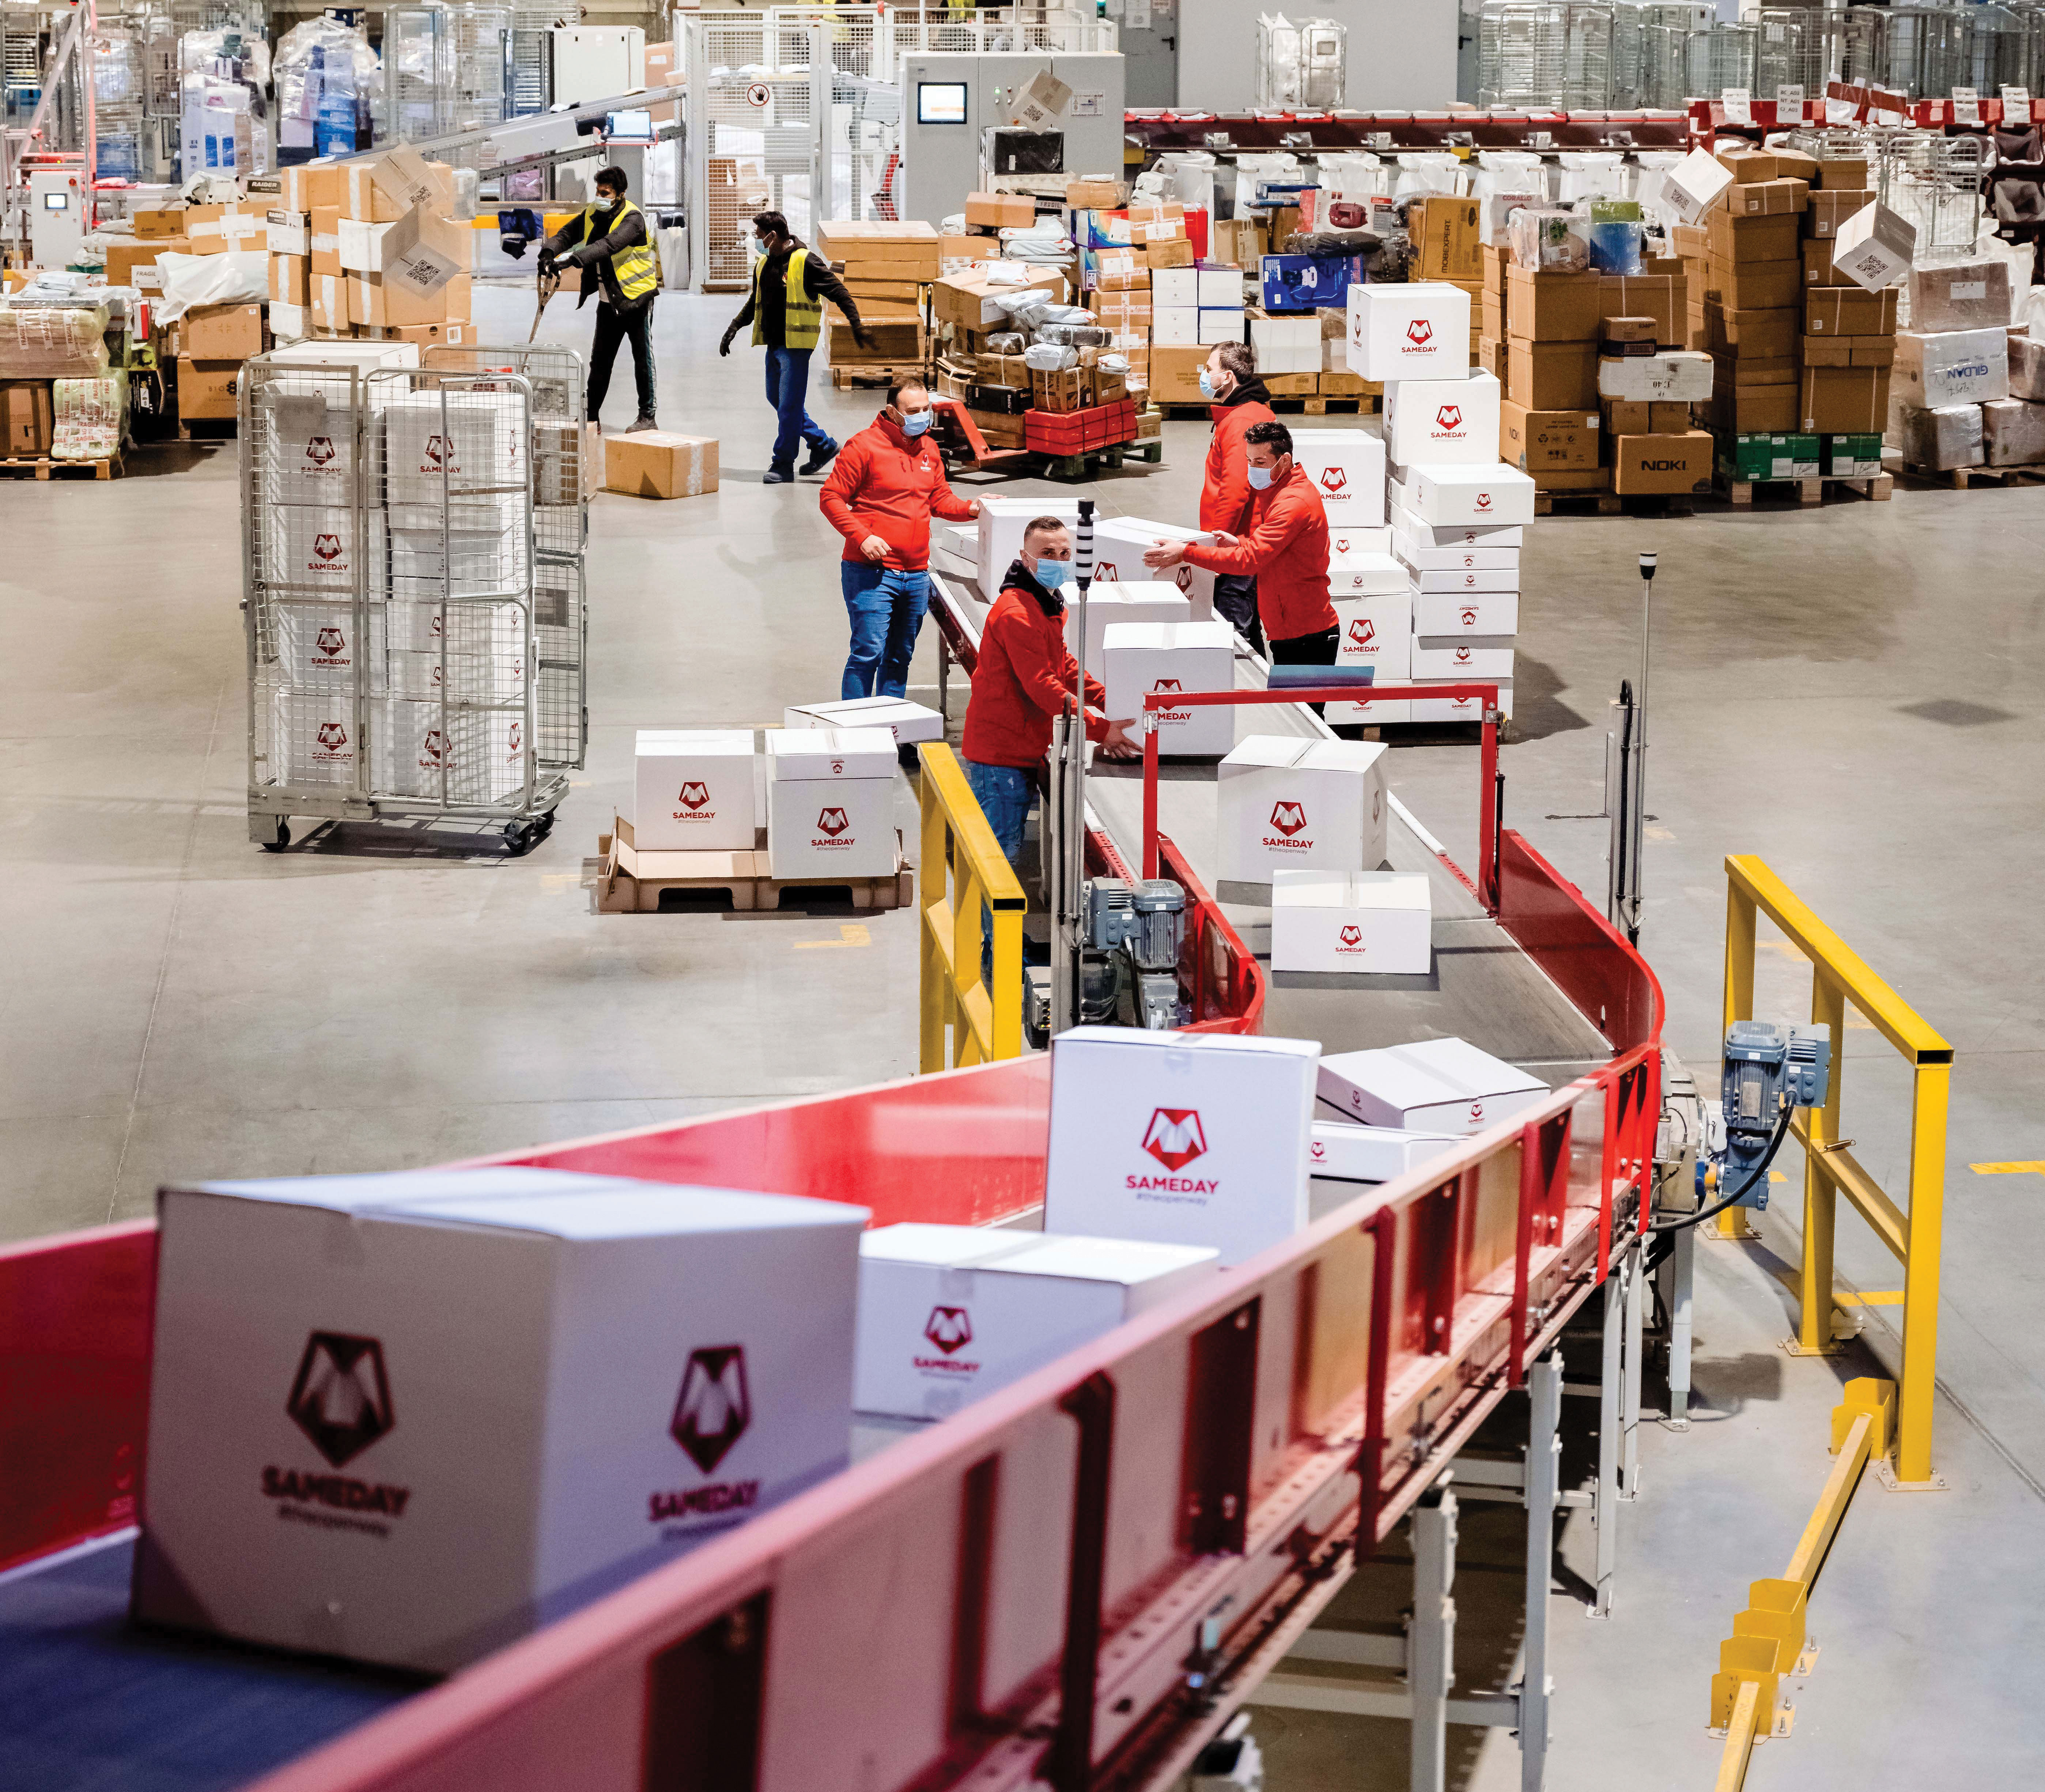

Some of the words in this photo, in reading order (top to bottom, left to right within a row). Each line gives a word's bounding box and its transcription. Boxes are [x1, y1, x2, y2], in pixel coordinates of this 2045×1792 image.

[1441, 219, 1451, 273] MOBEXPERT
[1947, 365, 1988, 379] GILDAN
[1641, 460, 1686, 472] NOKI
[308, 563, 348, 571] SAMEDAY
[1262, 837, 1314, 849] SAMEDAY
[1269, 846, 1308, 854] #theopenway
[1126, 1175, 1220, 1193] SAMEDAY
[914, 1355, 980, 1372] SAMEDAY
[261, 1465, 410, 1516] SAMEDAY
[649, 1480, 761, 1521] SAMEDAY
